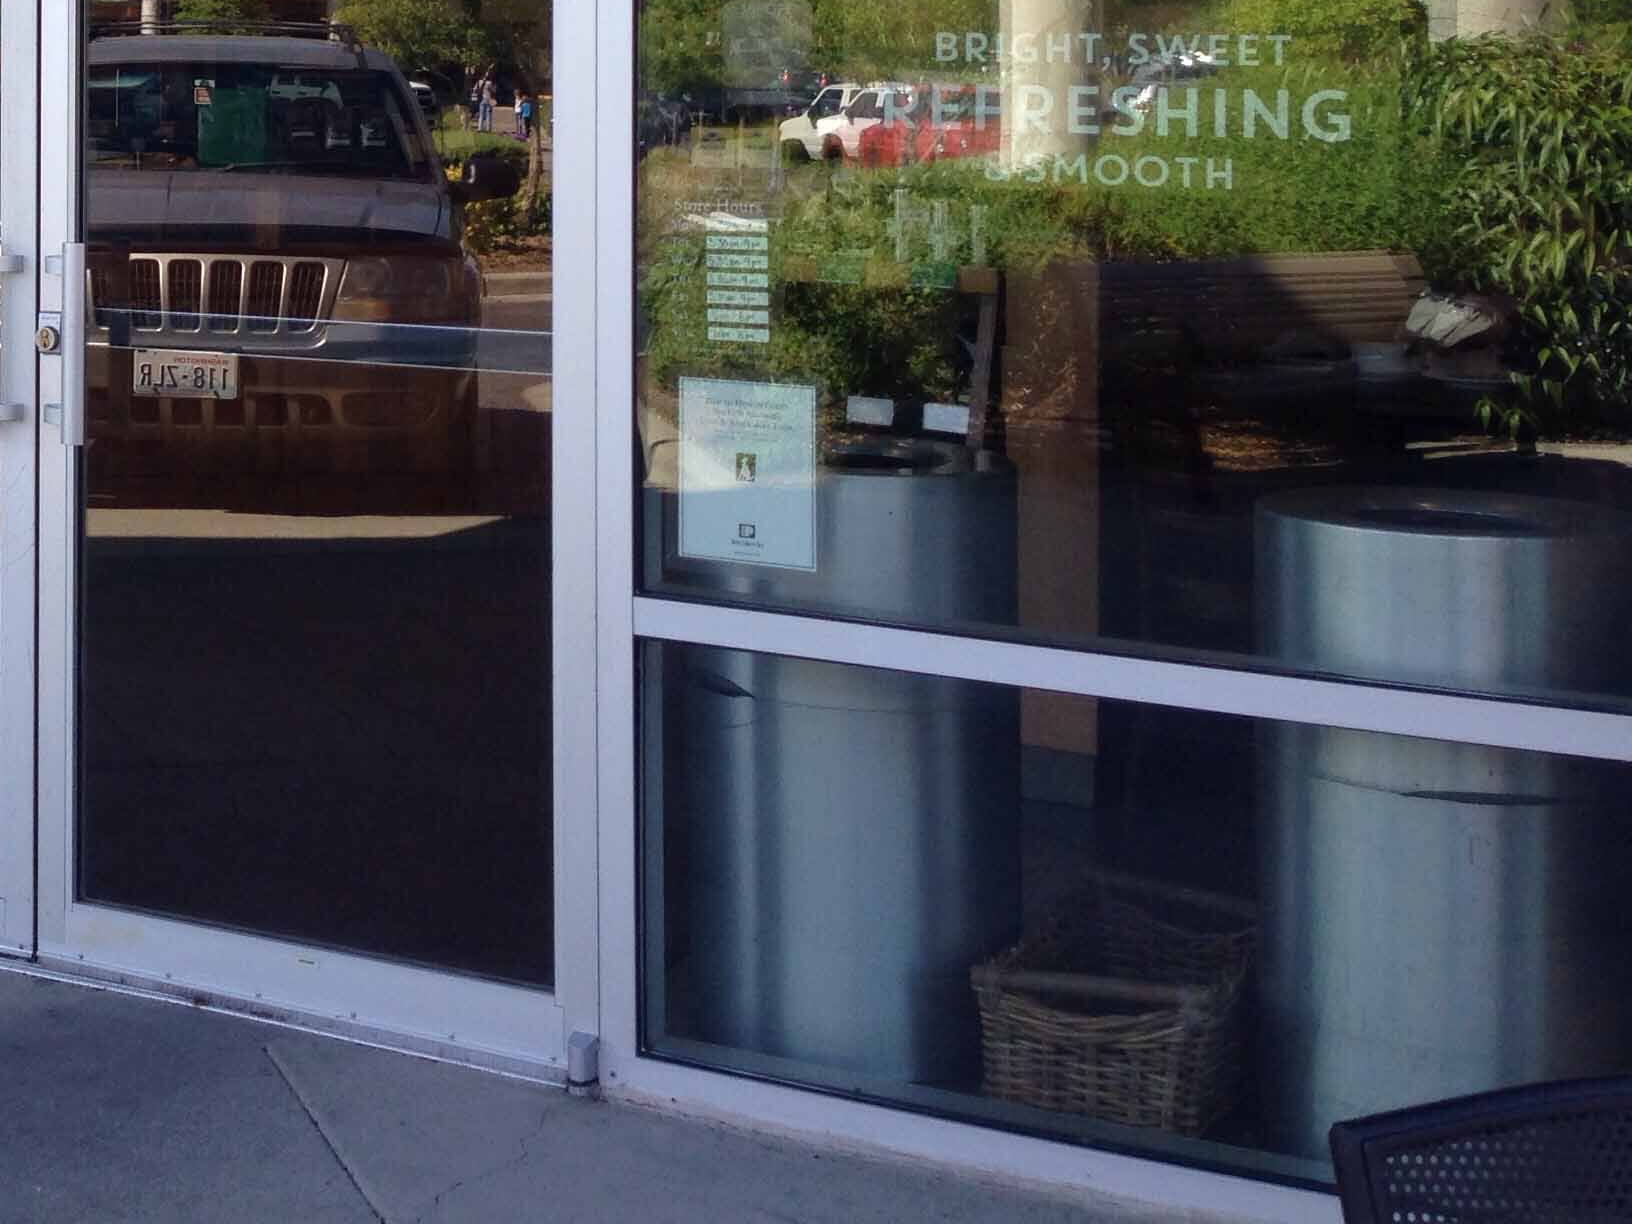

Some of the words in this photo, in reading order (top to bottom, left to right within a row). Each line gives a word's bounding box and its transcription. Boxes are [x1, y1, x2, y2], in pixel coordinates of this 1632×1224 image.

[935, 31, 1112, 71] BRIGHT,
[1128, 33, 1292, 67] SWEET
[883, 84, 1353, 143] REFRESHING
[1022, 152, 1233, 190] SMOOTH
